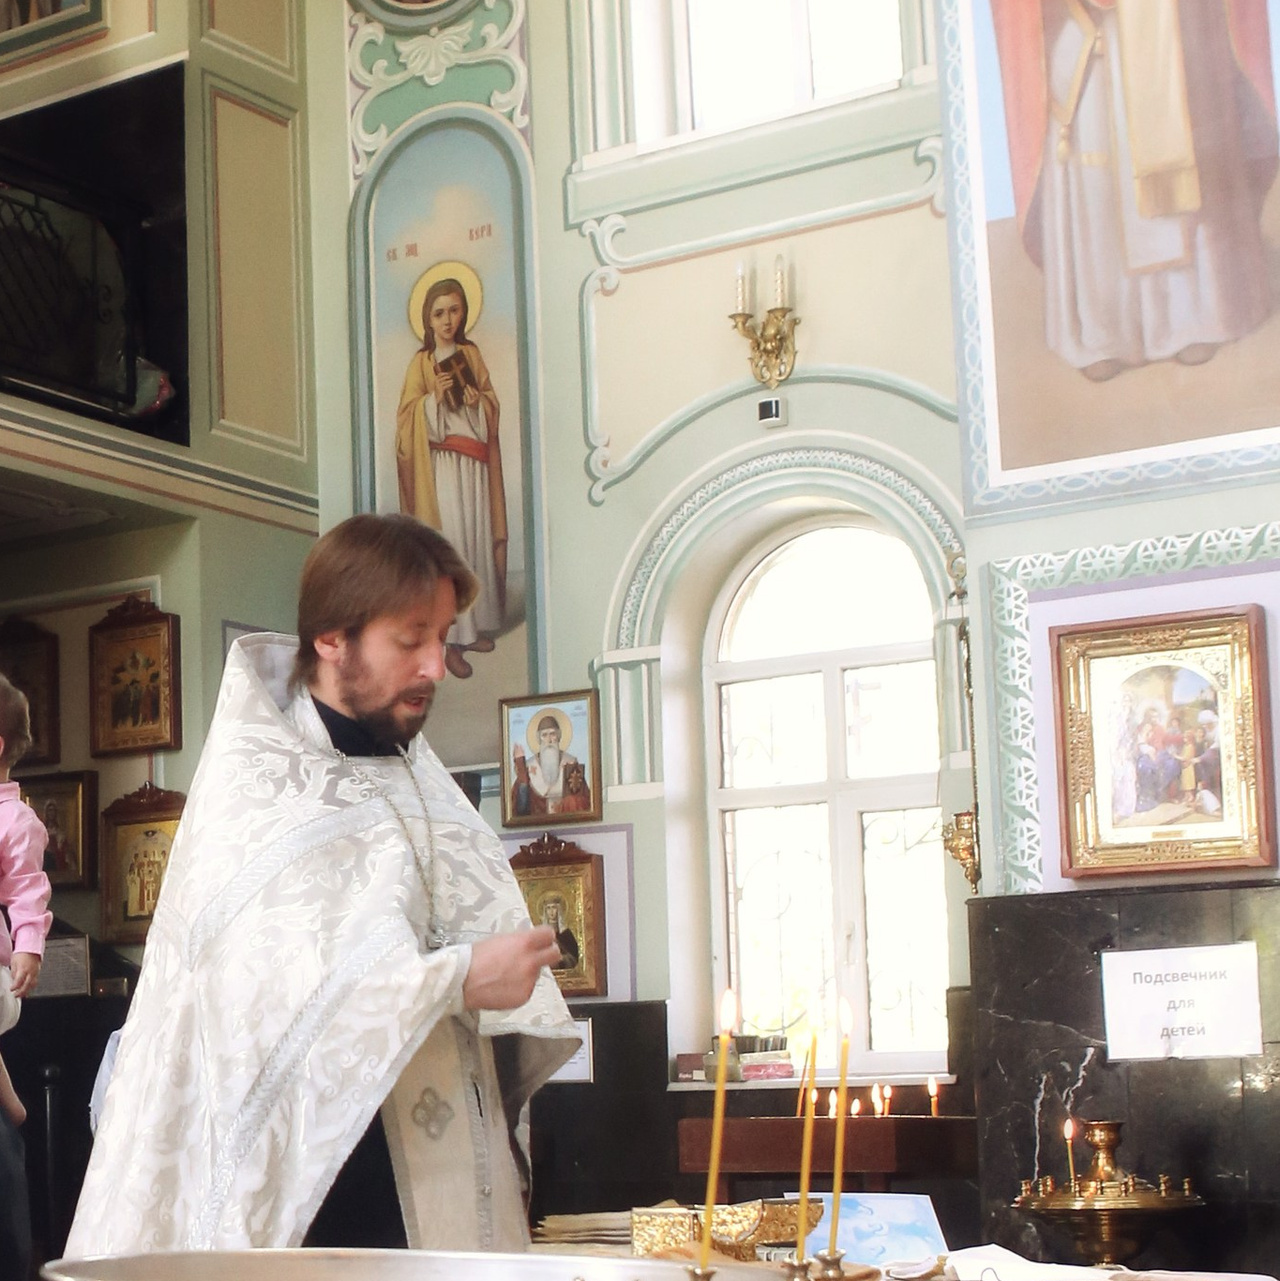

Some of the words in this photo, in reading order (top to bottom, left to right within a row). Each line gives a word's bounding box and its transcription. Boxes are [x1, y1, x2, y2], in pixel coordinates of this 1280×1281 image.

[1132, 969, 1228, 985] Подсвечник
[1167, 998, 1196, 1012] для
[1160, 1022, 1206, 1039] детей
